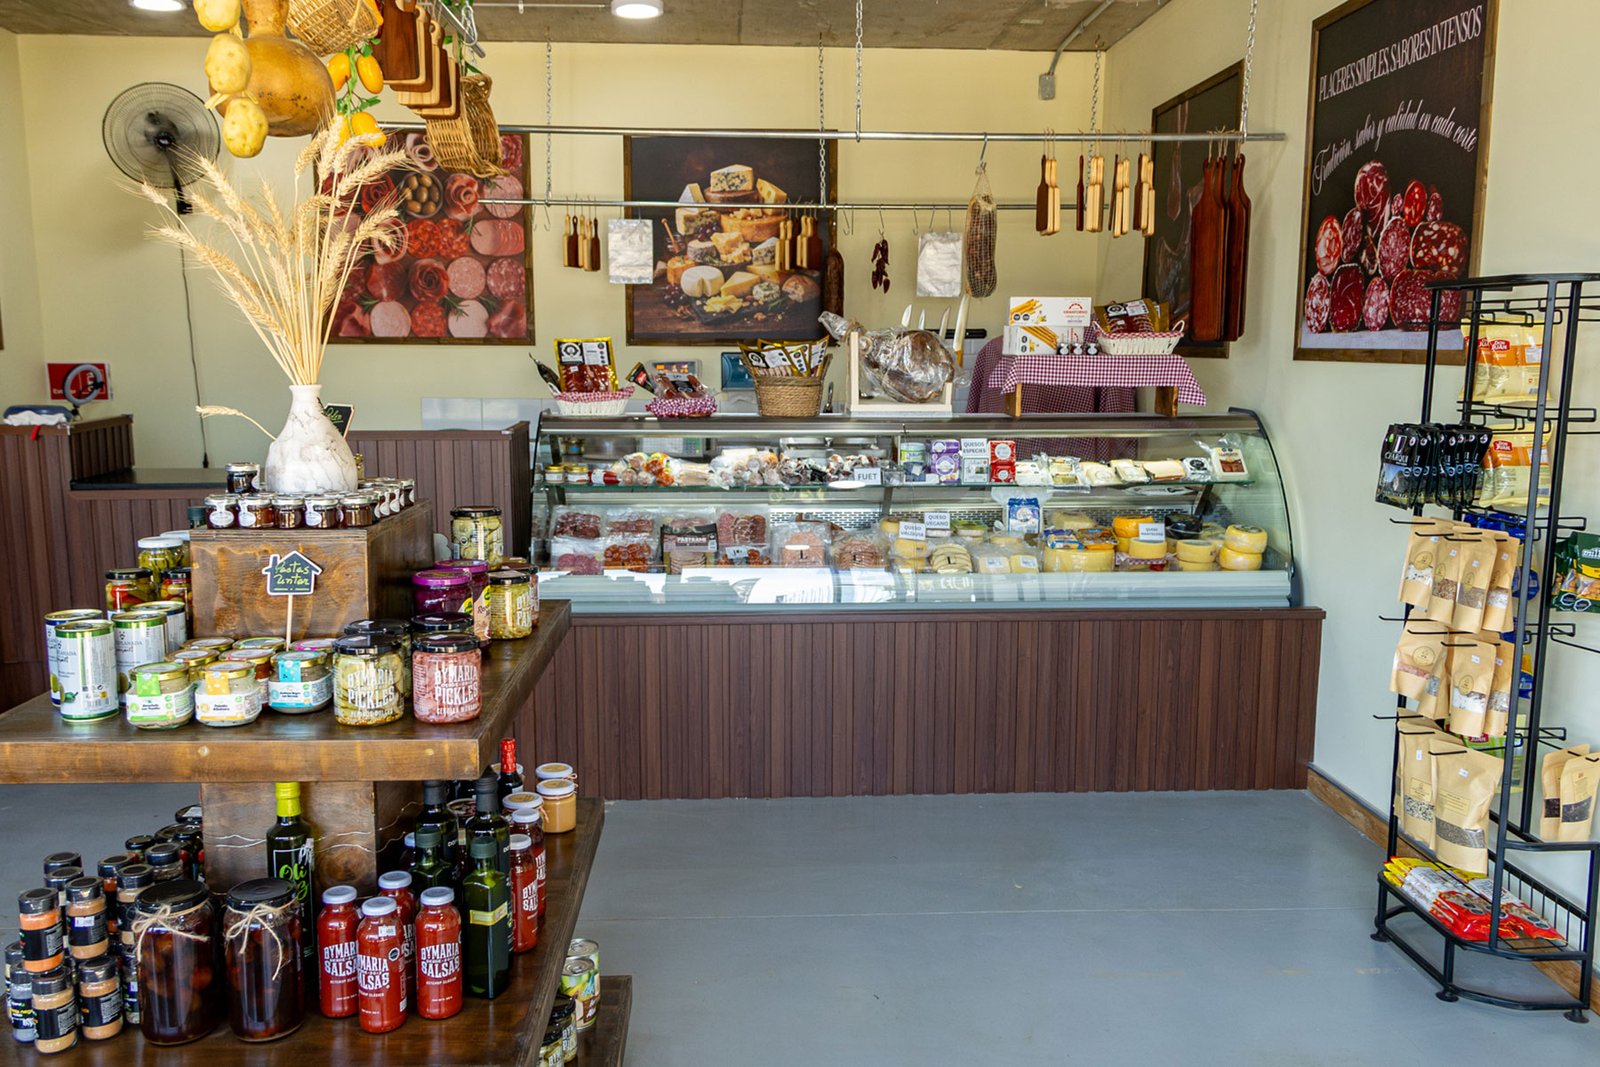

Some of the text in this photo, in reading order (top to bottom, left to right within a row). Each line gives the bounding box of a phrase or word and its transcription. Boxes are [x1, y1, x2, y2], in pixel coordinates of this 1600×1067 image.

[1318, 63, 1357, 102] PLACERES
[1390, 28, 1432, 73] SABORES
[1431, 5, 1483, 55] INTENSOS
[1355, 113, 1376, 150] sabor
[1374, 119, 1384, 152] y
[1385, 99, 1423, 133] calidad
[1420, 111, 1431, 131] en
[1431, 107, 1456, 137] cada
[1452, 122, 1477, 153] corte
[857, 472, 877, 481] FUET
[274, 560, 310, 575] Pastas
[347, 667, 395, 687] BYMARIA
[434, 664, 478, 686] BYMARIA
[347, 686, 395, 709] PICKLES
[434, 682, 479, 706] PICKLES
[323, 940, 359, 960] BYMARI
[420, 942, 460, 960] BYMARIA
[421, 956, 460, 979] SALSAS
